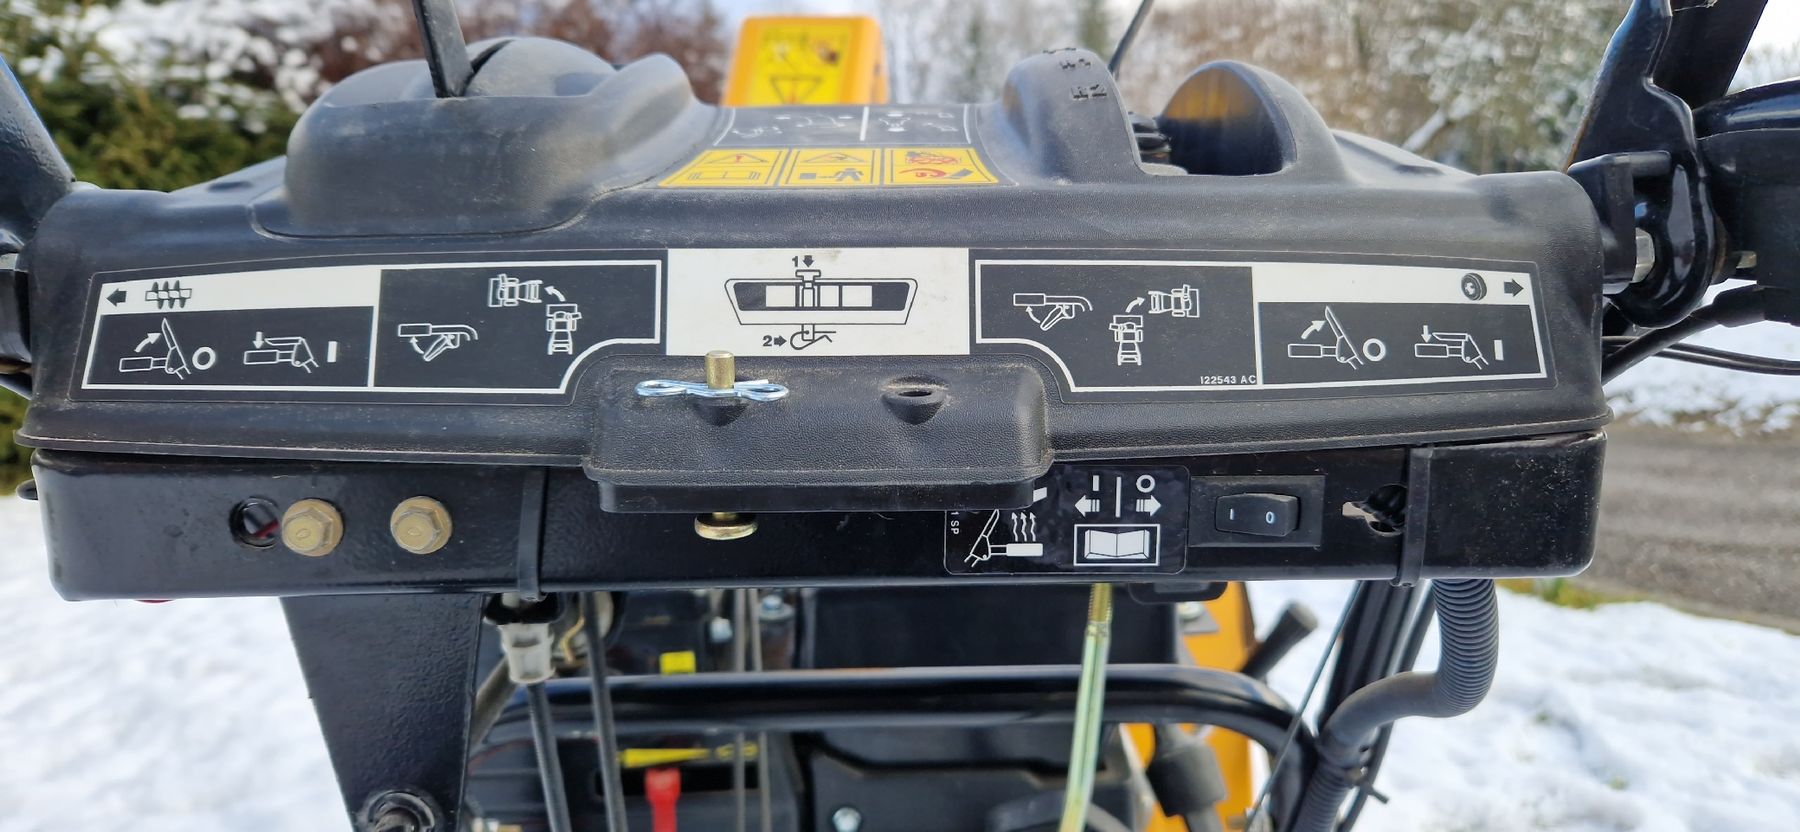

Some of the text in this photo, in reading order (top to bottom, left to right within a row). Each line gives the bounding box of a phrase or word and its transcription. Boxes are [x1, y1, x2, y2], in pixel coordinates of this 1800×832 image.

[792, 256, 799, 267] 1
[762, 335, 772, 346] 2
[1240, 374, 1257, 384] AC
[950, 520, 960, 535] SP
